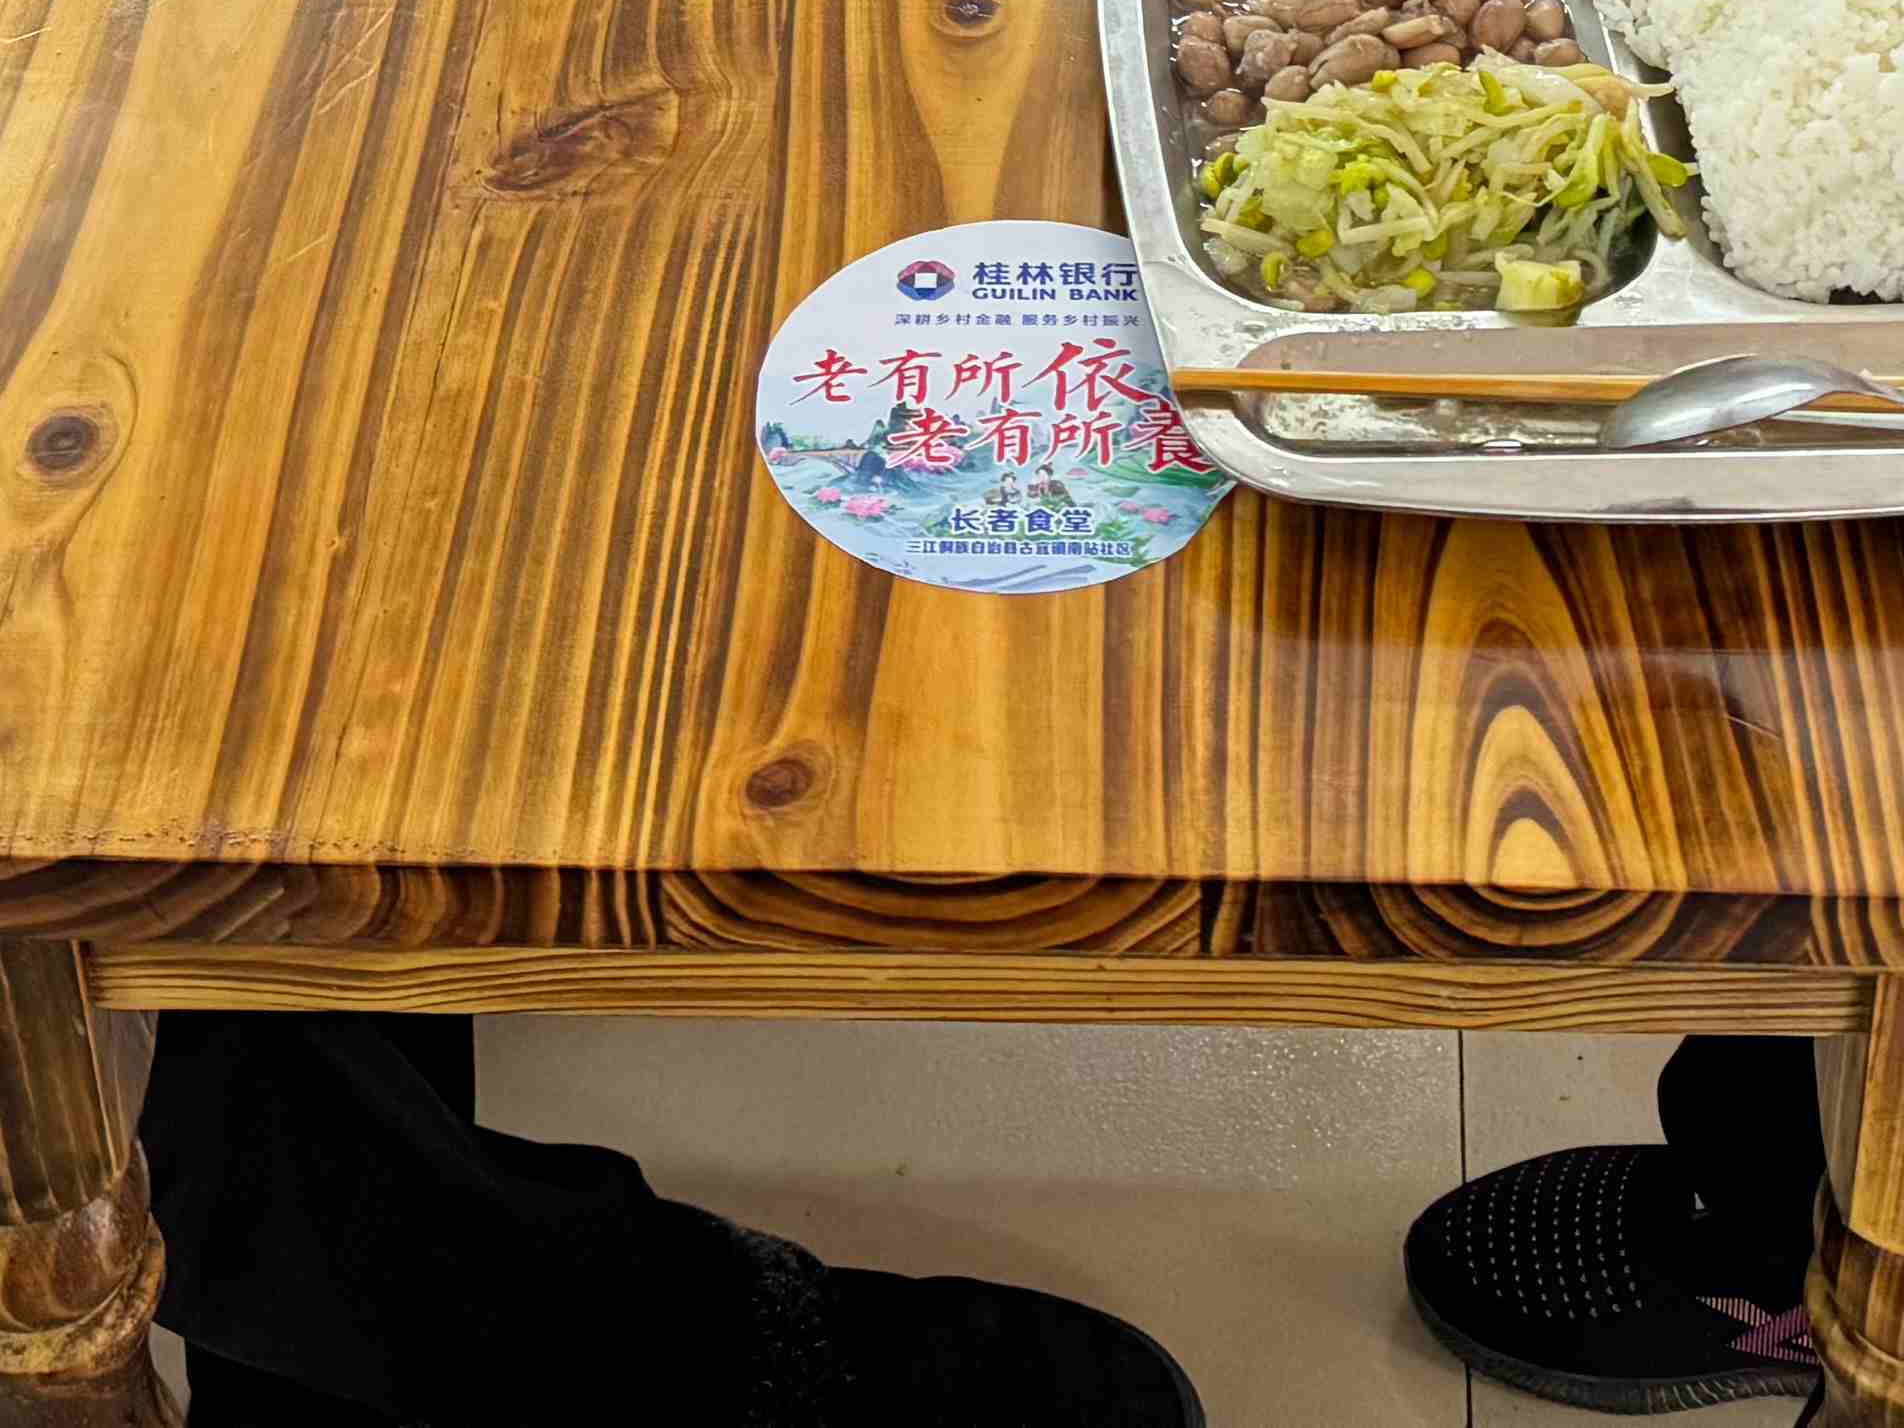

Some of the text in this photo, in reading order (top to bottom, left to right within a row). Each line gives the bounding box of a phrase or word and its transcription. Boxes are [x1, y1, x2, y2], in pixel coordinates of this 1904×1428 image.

[971, 261, 1138, 287] 桂林银行
[971, 288, 1138, 302] GUILIN BANK
[894, 313, 1141, 327] 深耕乡村金融 服务乡村振兴
[788, 338, 1162, 412] 老有所依
[951, 508, 1093, 533] 长者食堂
